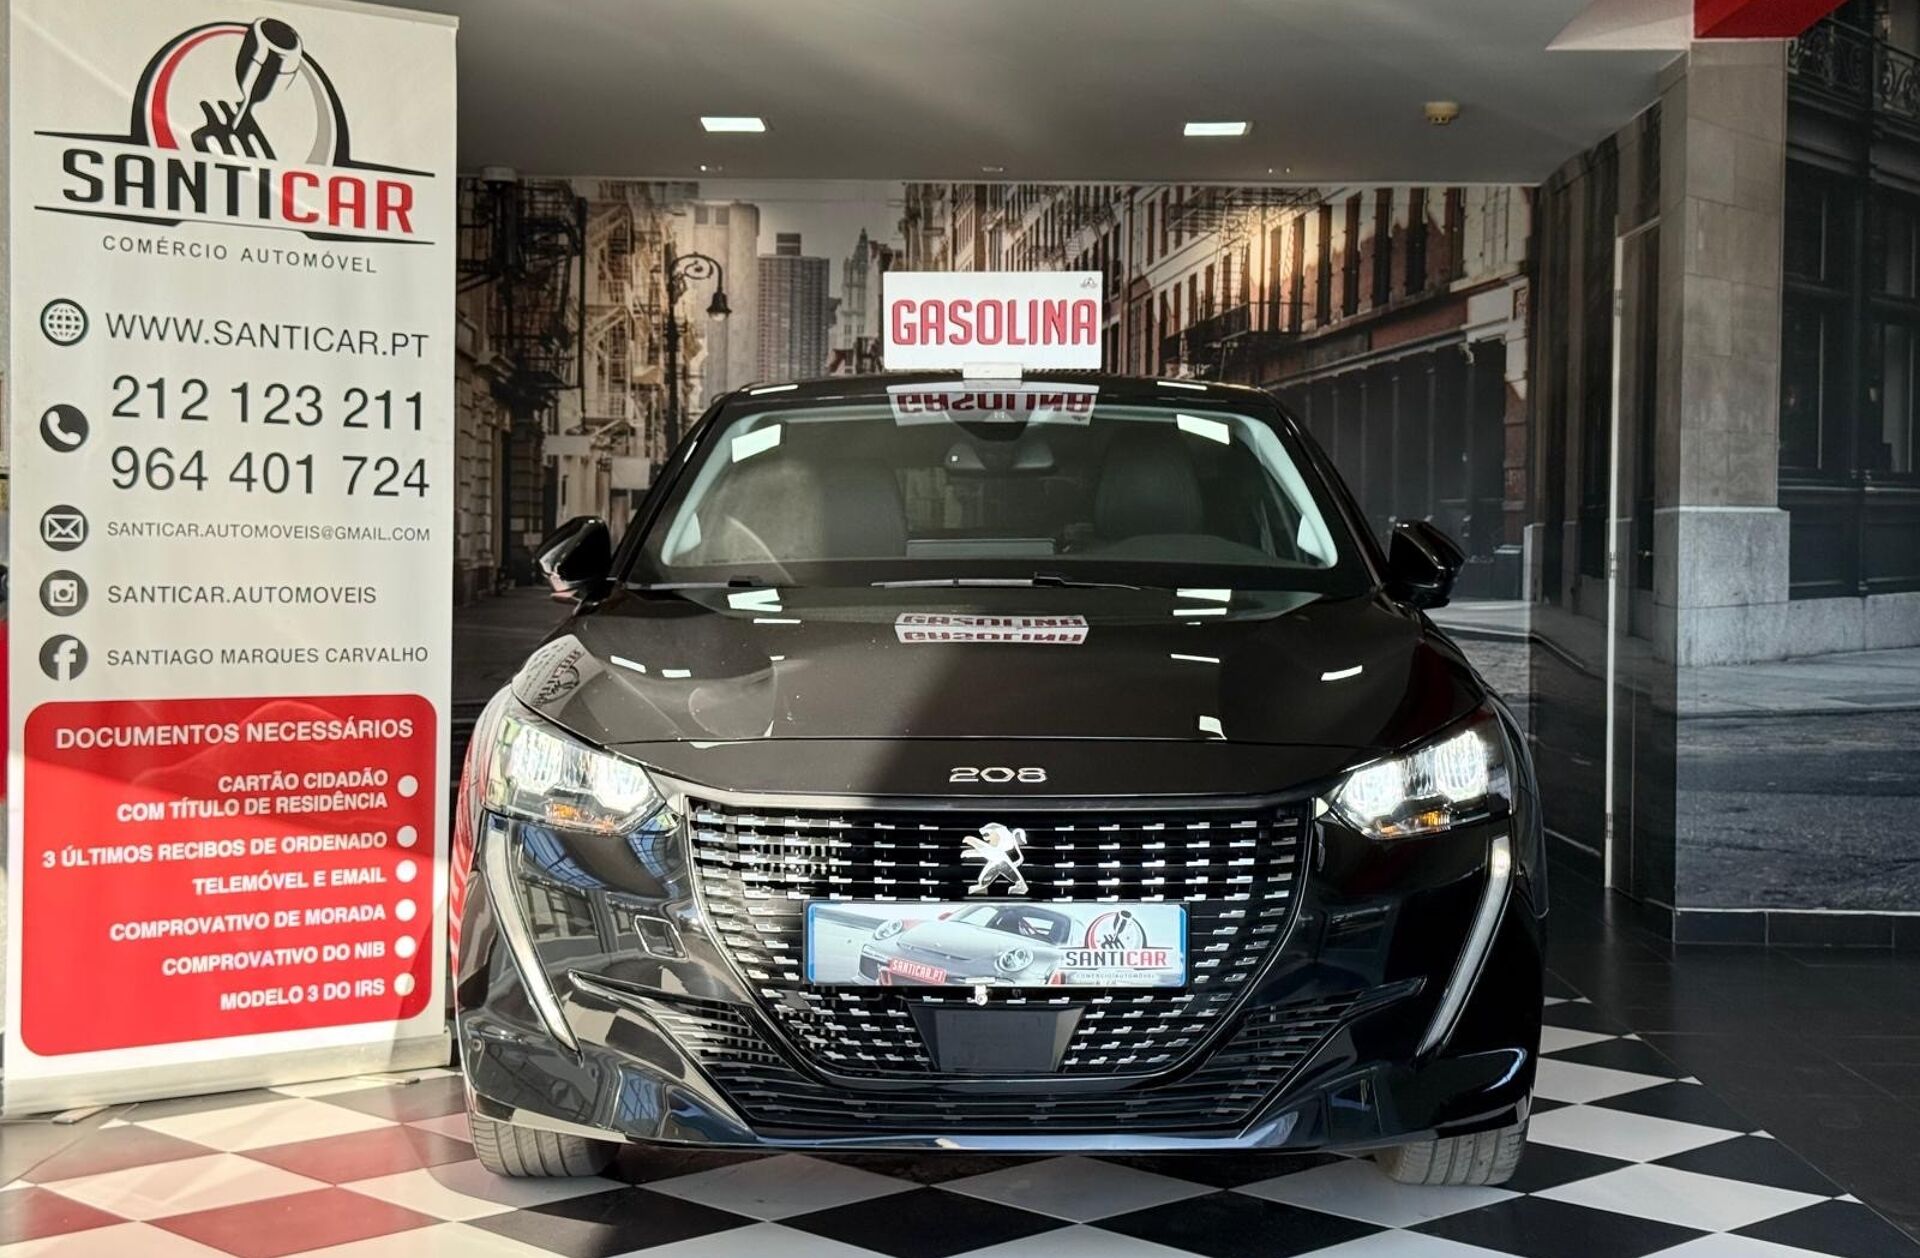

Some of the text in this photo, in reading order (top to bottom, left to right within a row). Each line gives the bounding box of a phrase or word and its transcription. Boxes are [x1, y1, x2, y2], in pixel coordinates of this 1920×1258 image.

[63, 148, 414, 234] SANTICAR
[102, 235, 378, 274] COMÉRCIO AUTOMÓVEL
[105, 312, 430, 358] WWW.SANTICAR.PT
[892, 299, 1097, 346] GASOLINA
[112, 373, 424, 431] 212 123 211
[111, 445, 431, 498] 964 401 724
[107, 521, 431, 542] SANTICAR.AUTOMOVEIS@GMAIL.COM
[107, 585, 377, 604] SANTICAR.AUTOMOVEIS
[107, 646, 429, 666] SANTIAGO MARQUES CARVALHO
[56, 716, 414, 749] DOCUMENTOS NECESSÁRIOS
[218, 767, 388, 793] CARTÃO CIDADÃO
[949, 766, 1048, 783] 208
[117, 790, 388, 822] COM TÍTULO DE RESIDÊNCIA
[43, 832, 388, 868] 3 ÚLTIMOS RECIBOS DE ORDENADO
[192, 867, 388, 895] TELEMÓVEL E EMAIL
[110, 904, 386, 941] COMPROVATIVO DE MORADA
[162, 941, 386, 976] COMPROVATIVO DO NIB
[1065, 951, 1167, 966] SANTICAR
[220, 978, 386, 1010] MODELO 3 DO IRS
